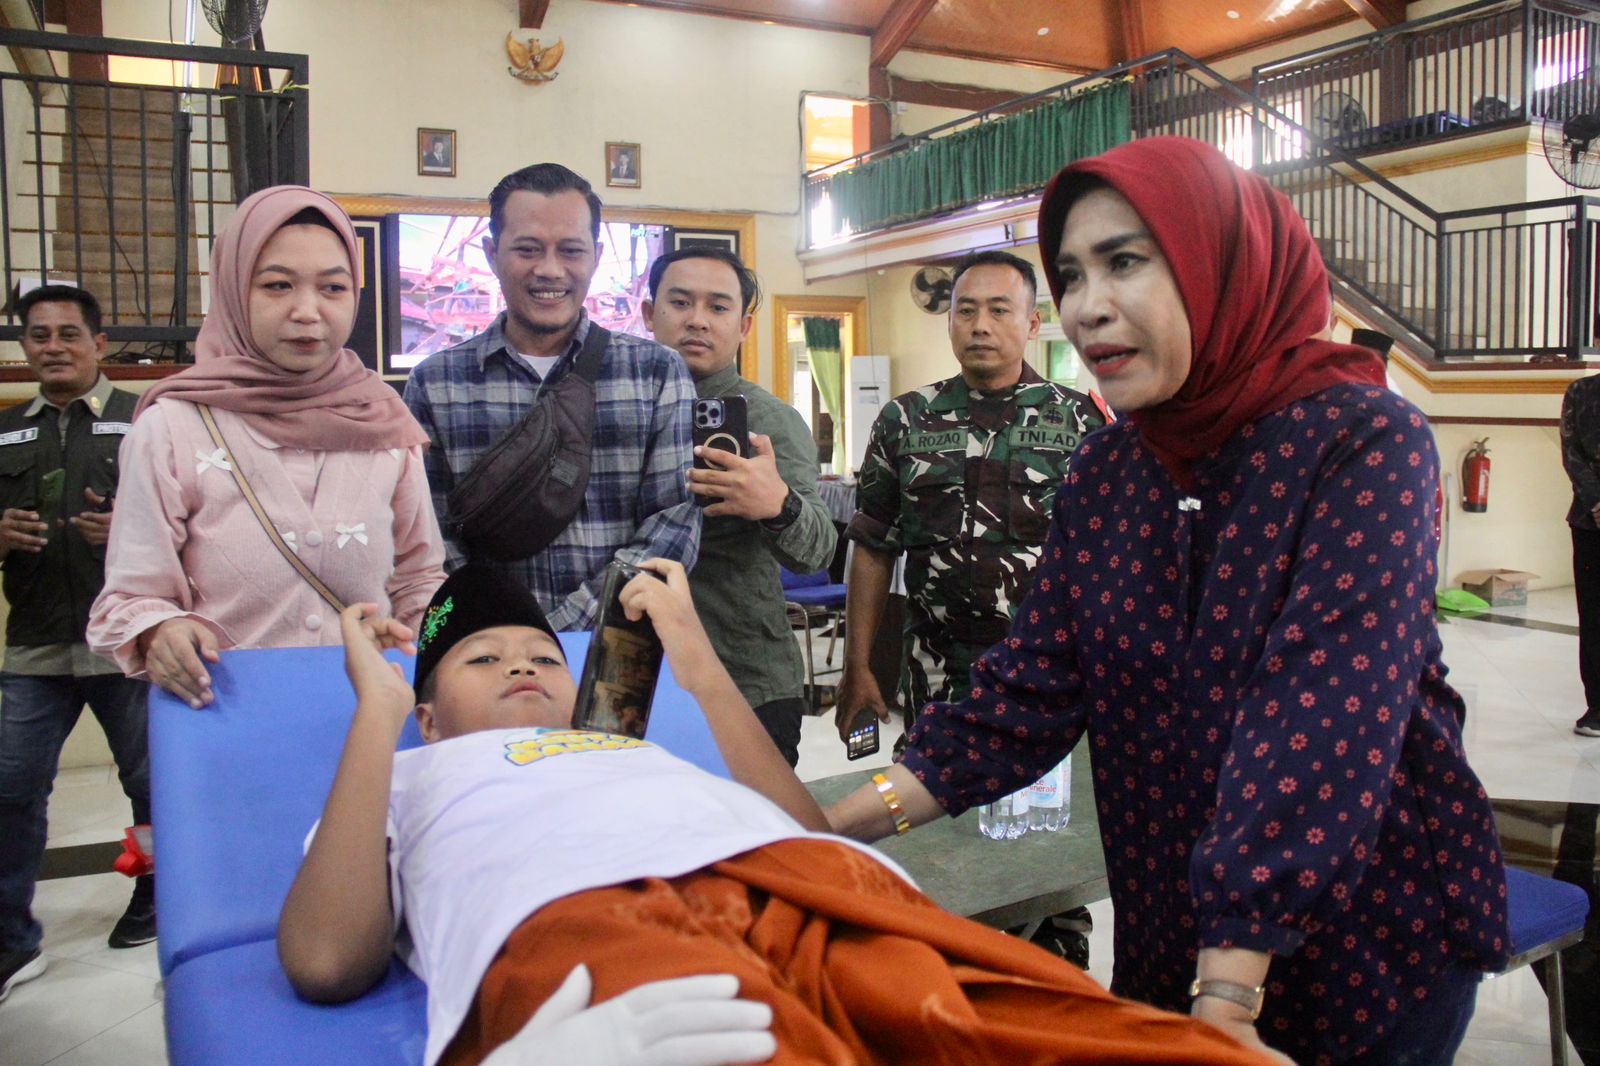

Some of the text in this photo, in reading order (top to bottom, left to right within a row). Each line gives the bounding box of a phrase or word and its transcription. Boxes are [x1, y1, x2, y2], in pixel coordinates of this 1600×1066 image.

[903, 432, 961, 449] A. ROZAQ
[1018, 430, 1076, 447] TNI-AD
